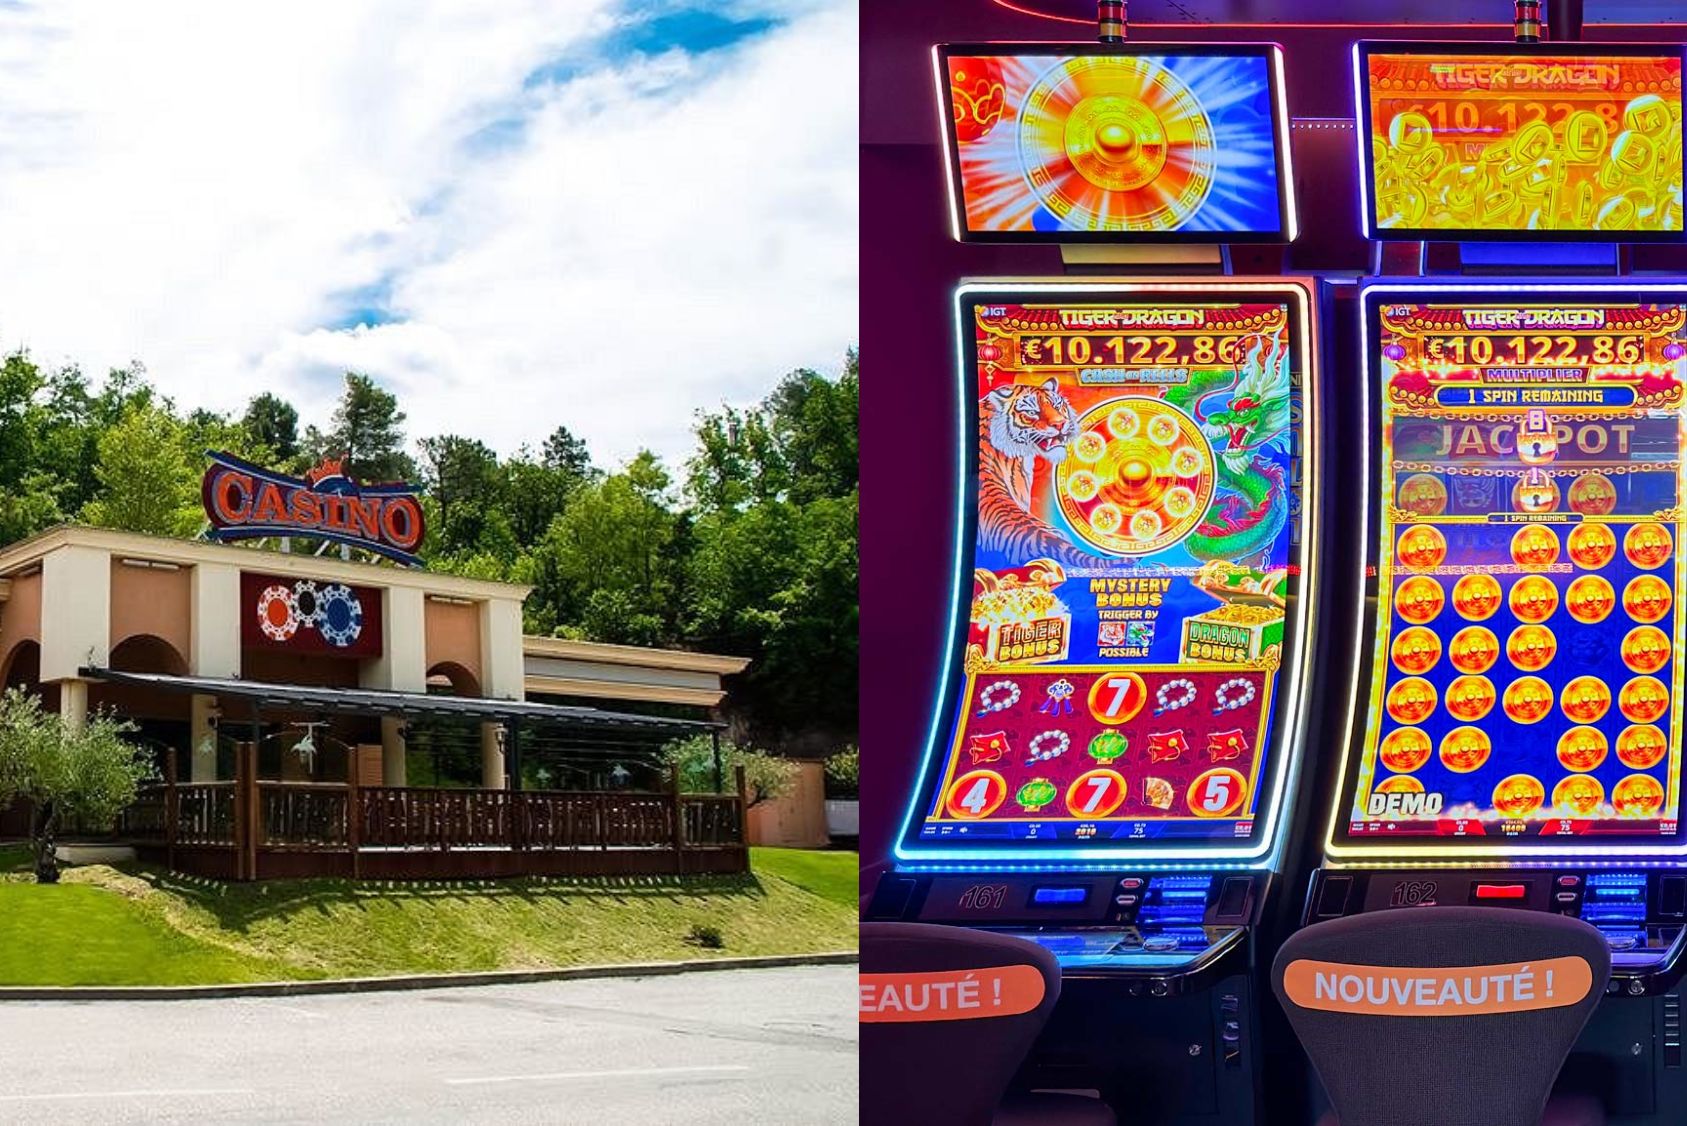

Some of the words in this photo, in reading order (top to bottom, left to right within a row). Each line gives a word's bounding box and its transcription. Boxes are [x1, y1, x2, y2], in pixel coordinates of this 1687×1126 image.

[1514, 63, 1620, 84] DRAGON
[990, 307, 1006, 316] IGT
[1059, 309, 1117, 325] TIGER
[1121, 309, 1204, 325] DRAGON
[1395, 308, 1411, 316] IGT
[1462, 309, 1520, 325] TIGER
[1524, 309, 1605, 325] DRAGON
[1025, 336, 1241, 364] €10.122,86
[1428, 336, 1640, 365] €10.122,86
[1487, 368, 1583, 382] MULTIPLIER
[1468, 389, 1476, 404] 1
[1483, 390, 1518, 403] SPIN
[1521, 390, 1604, 403] REMAINING
[1436, 424, 1635, 454] JACPOT
[214, 471, 421, 545] CASINO
[1090, 578, 1172, 592] MYSTERY
[1096, 593, 1163, 607] BONUS
[1098, 610, 1143, 620] TRIGGER
[1144, 610, 1159, 619] BY
[1001, 620, 1062, 645] TIGER
[1190, 622, 1250, 648] DRAGON
[1000, 638, 1060, 660] BONUS
[1099, 647, 1150, 657] POSSIBLE
[1190, 642, 1246, 663] BONUS
[1106, 679, 1131, 717] 7
[961, 778, 991, 813] 4
[1083, 777, 1112, 812] 7
[1203, 775, 1231, 812] 5
[1368, 793, 1442, 815] DEMO
[960, 885, 1006, 909] 161
[1392, 881, 1437, 905] 162
[1315, 967, 1534, 1006] NOUVEAUTÉ
[1545, 970, 1554, 996] !
